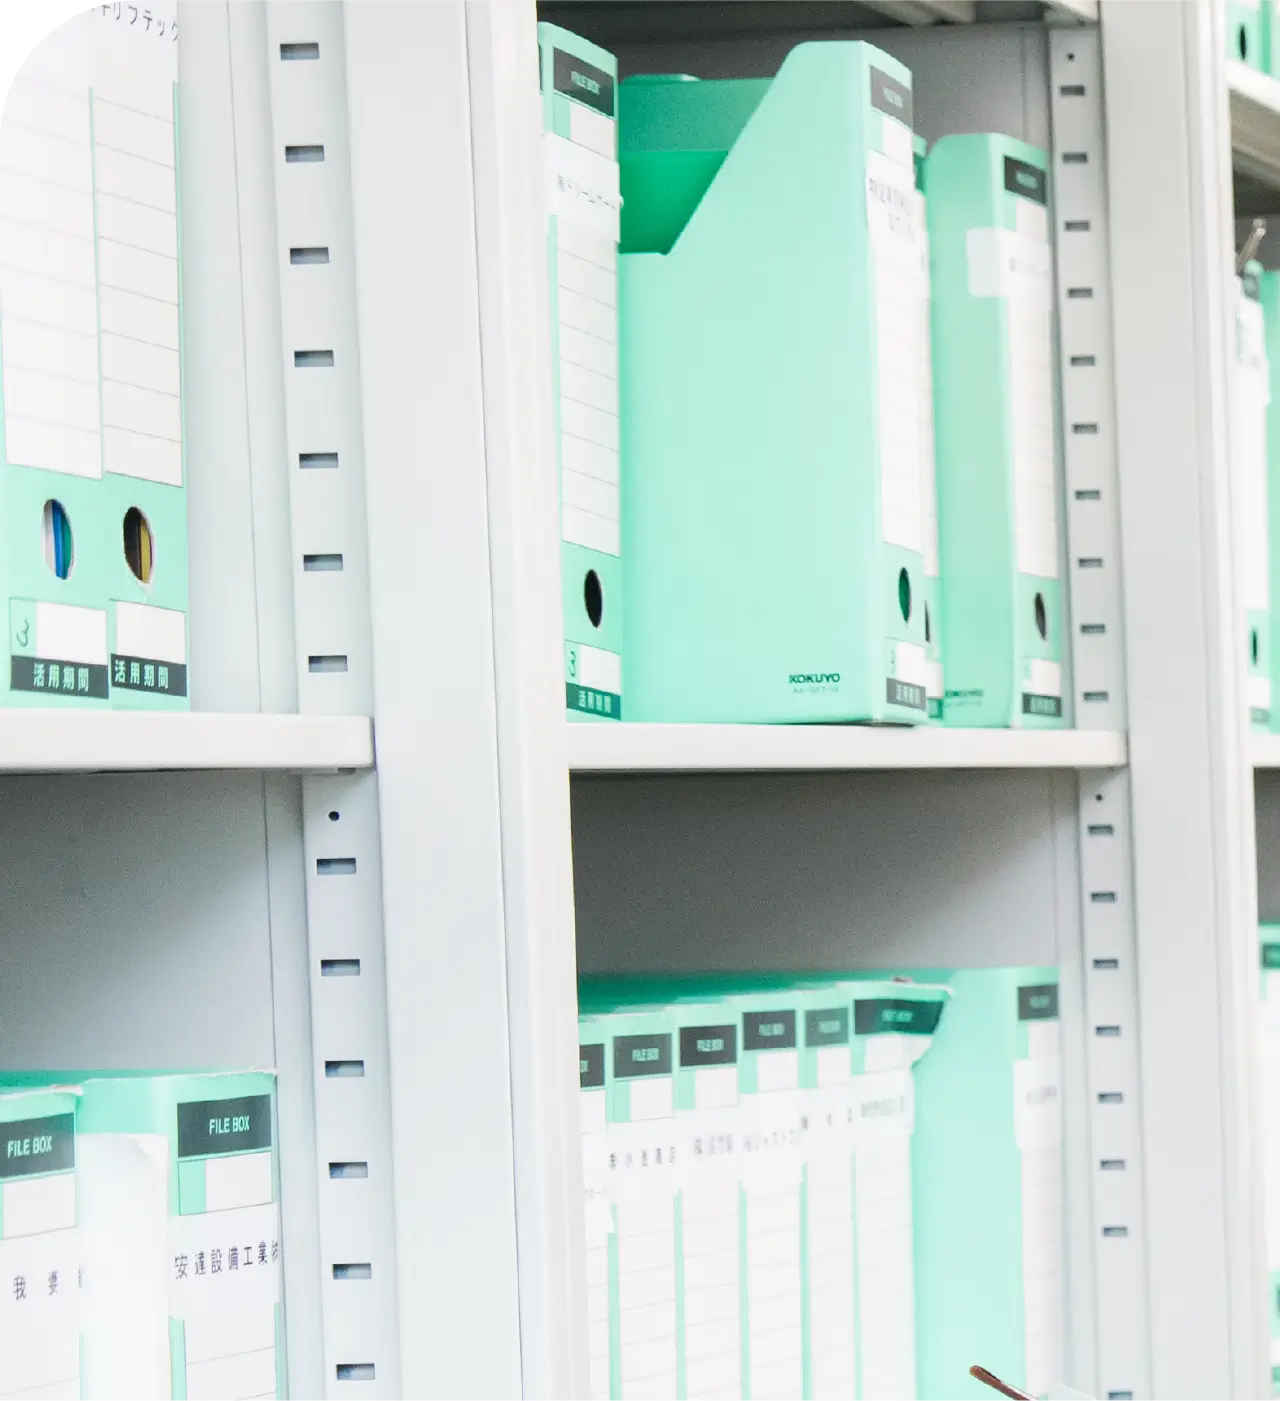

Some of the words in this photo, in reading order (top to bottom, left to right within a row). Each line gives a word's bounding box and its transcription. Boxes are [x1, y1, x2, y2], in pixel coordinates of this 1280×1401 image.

[33, 662, 89, 692] 活用期間
[114, 659, 169, 690] 活用期間
[788, 673, 841, 684] KOKUYO
[209, 1117, 230, 1135] FILE
[232, 1115, 250, 1132] BOX
[7, 1138, 31, 1159] FILE
[32, 1135, 53, 1156] BOX
